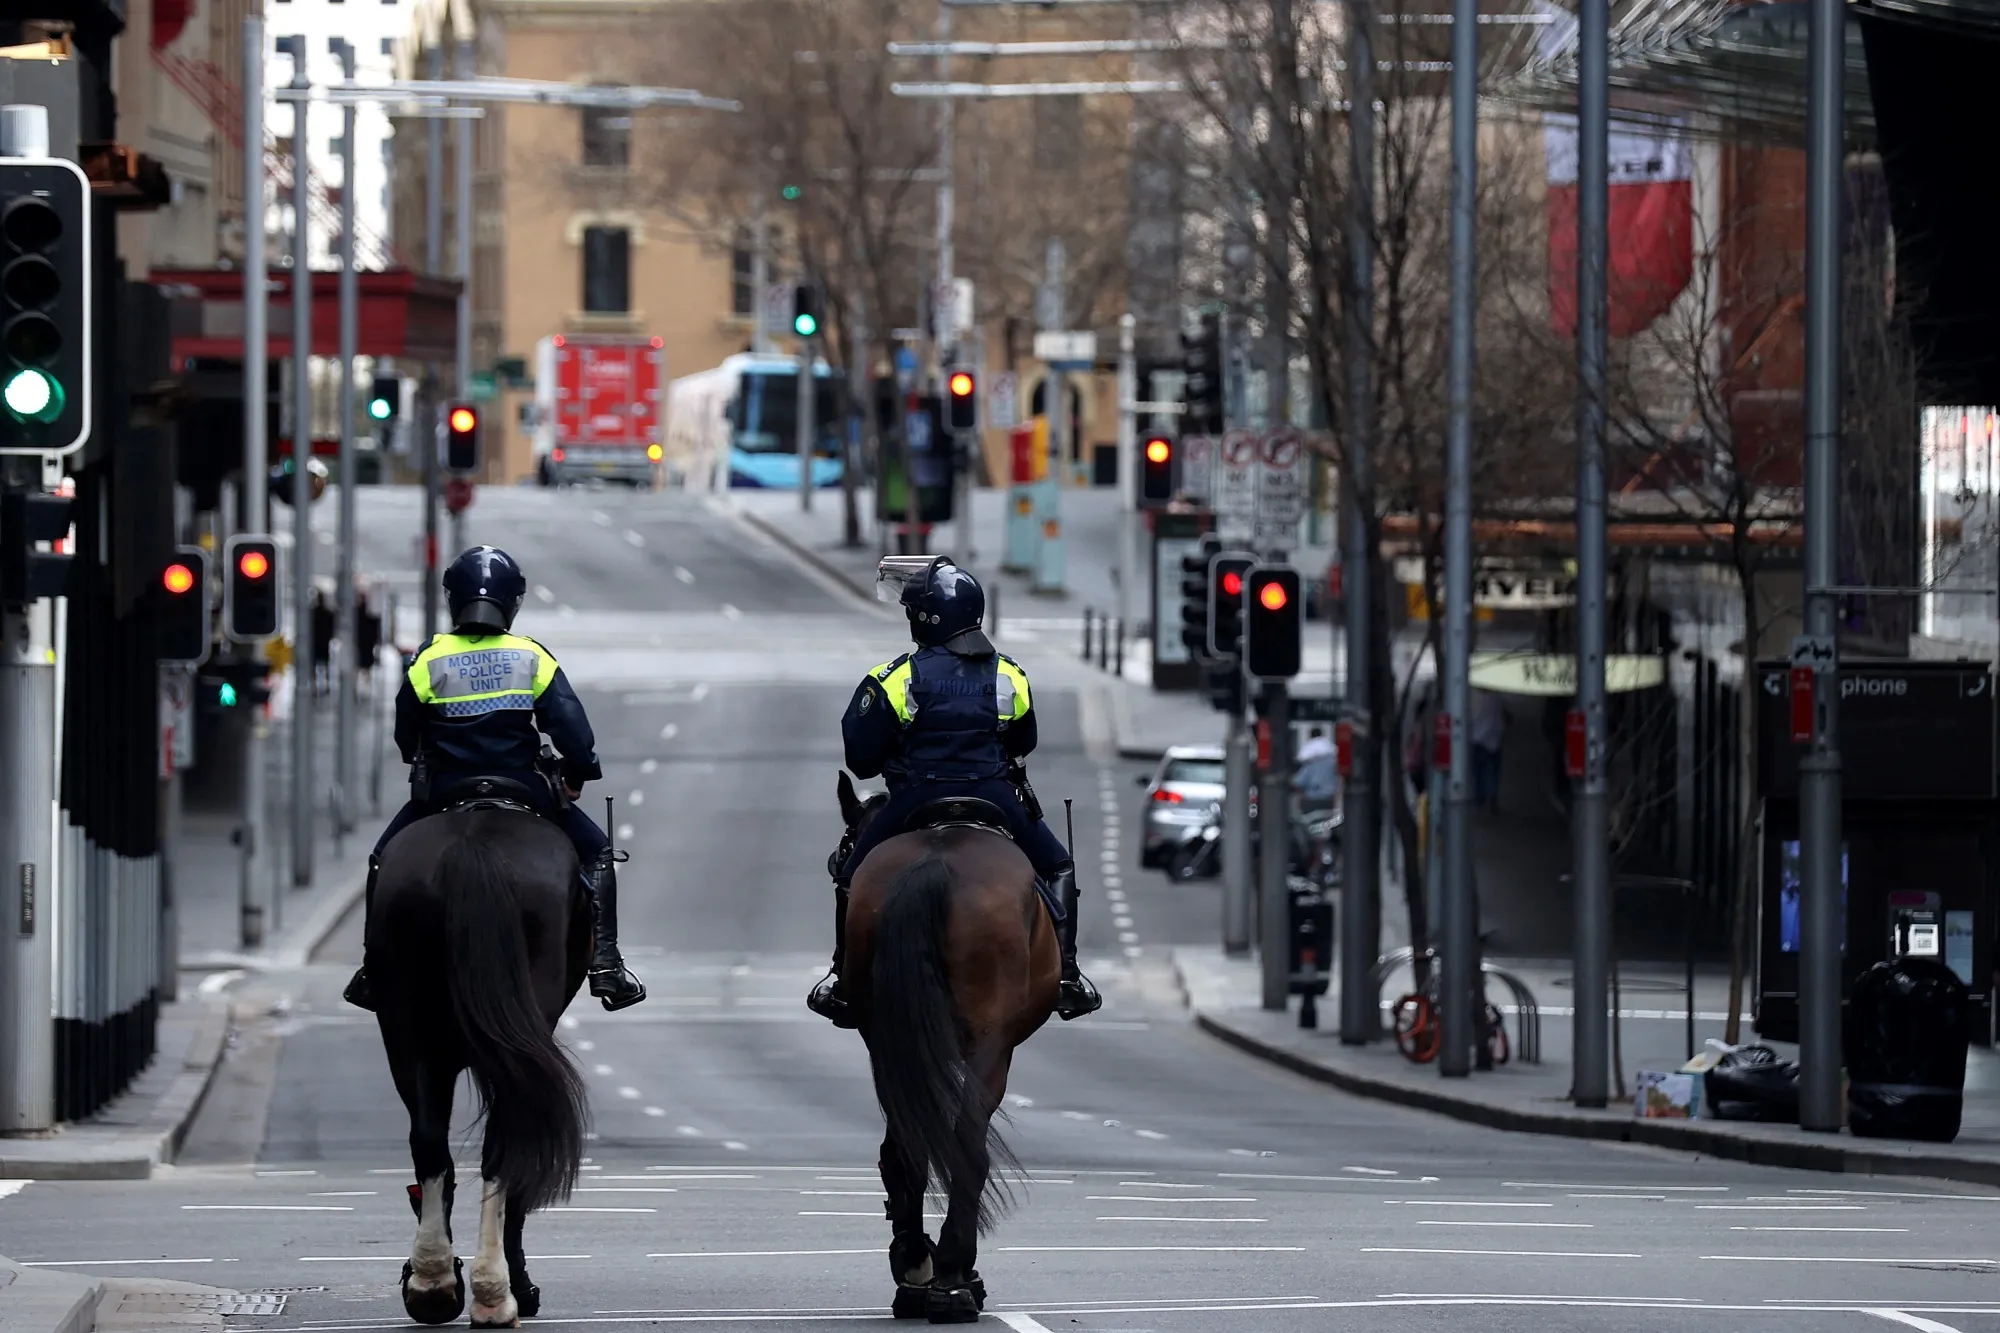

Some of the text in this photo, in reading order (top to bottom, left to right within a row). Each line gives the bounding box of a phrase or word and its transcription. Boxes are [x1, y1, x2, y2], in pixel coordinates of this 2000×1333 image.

[449, 651, 520, 667] MOUNTED
[460, 664, 511, 679] POLICE
[471, 678, 502, 691] UNIT
[1841, 676, 1907, 698] phone
